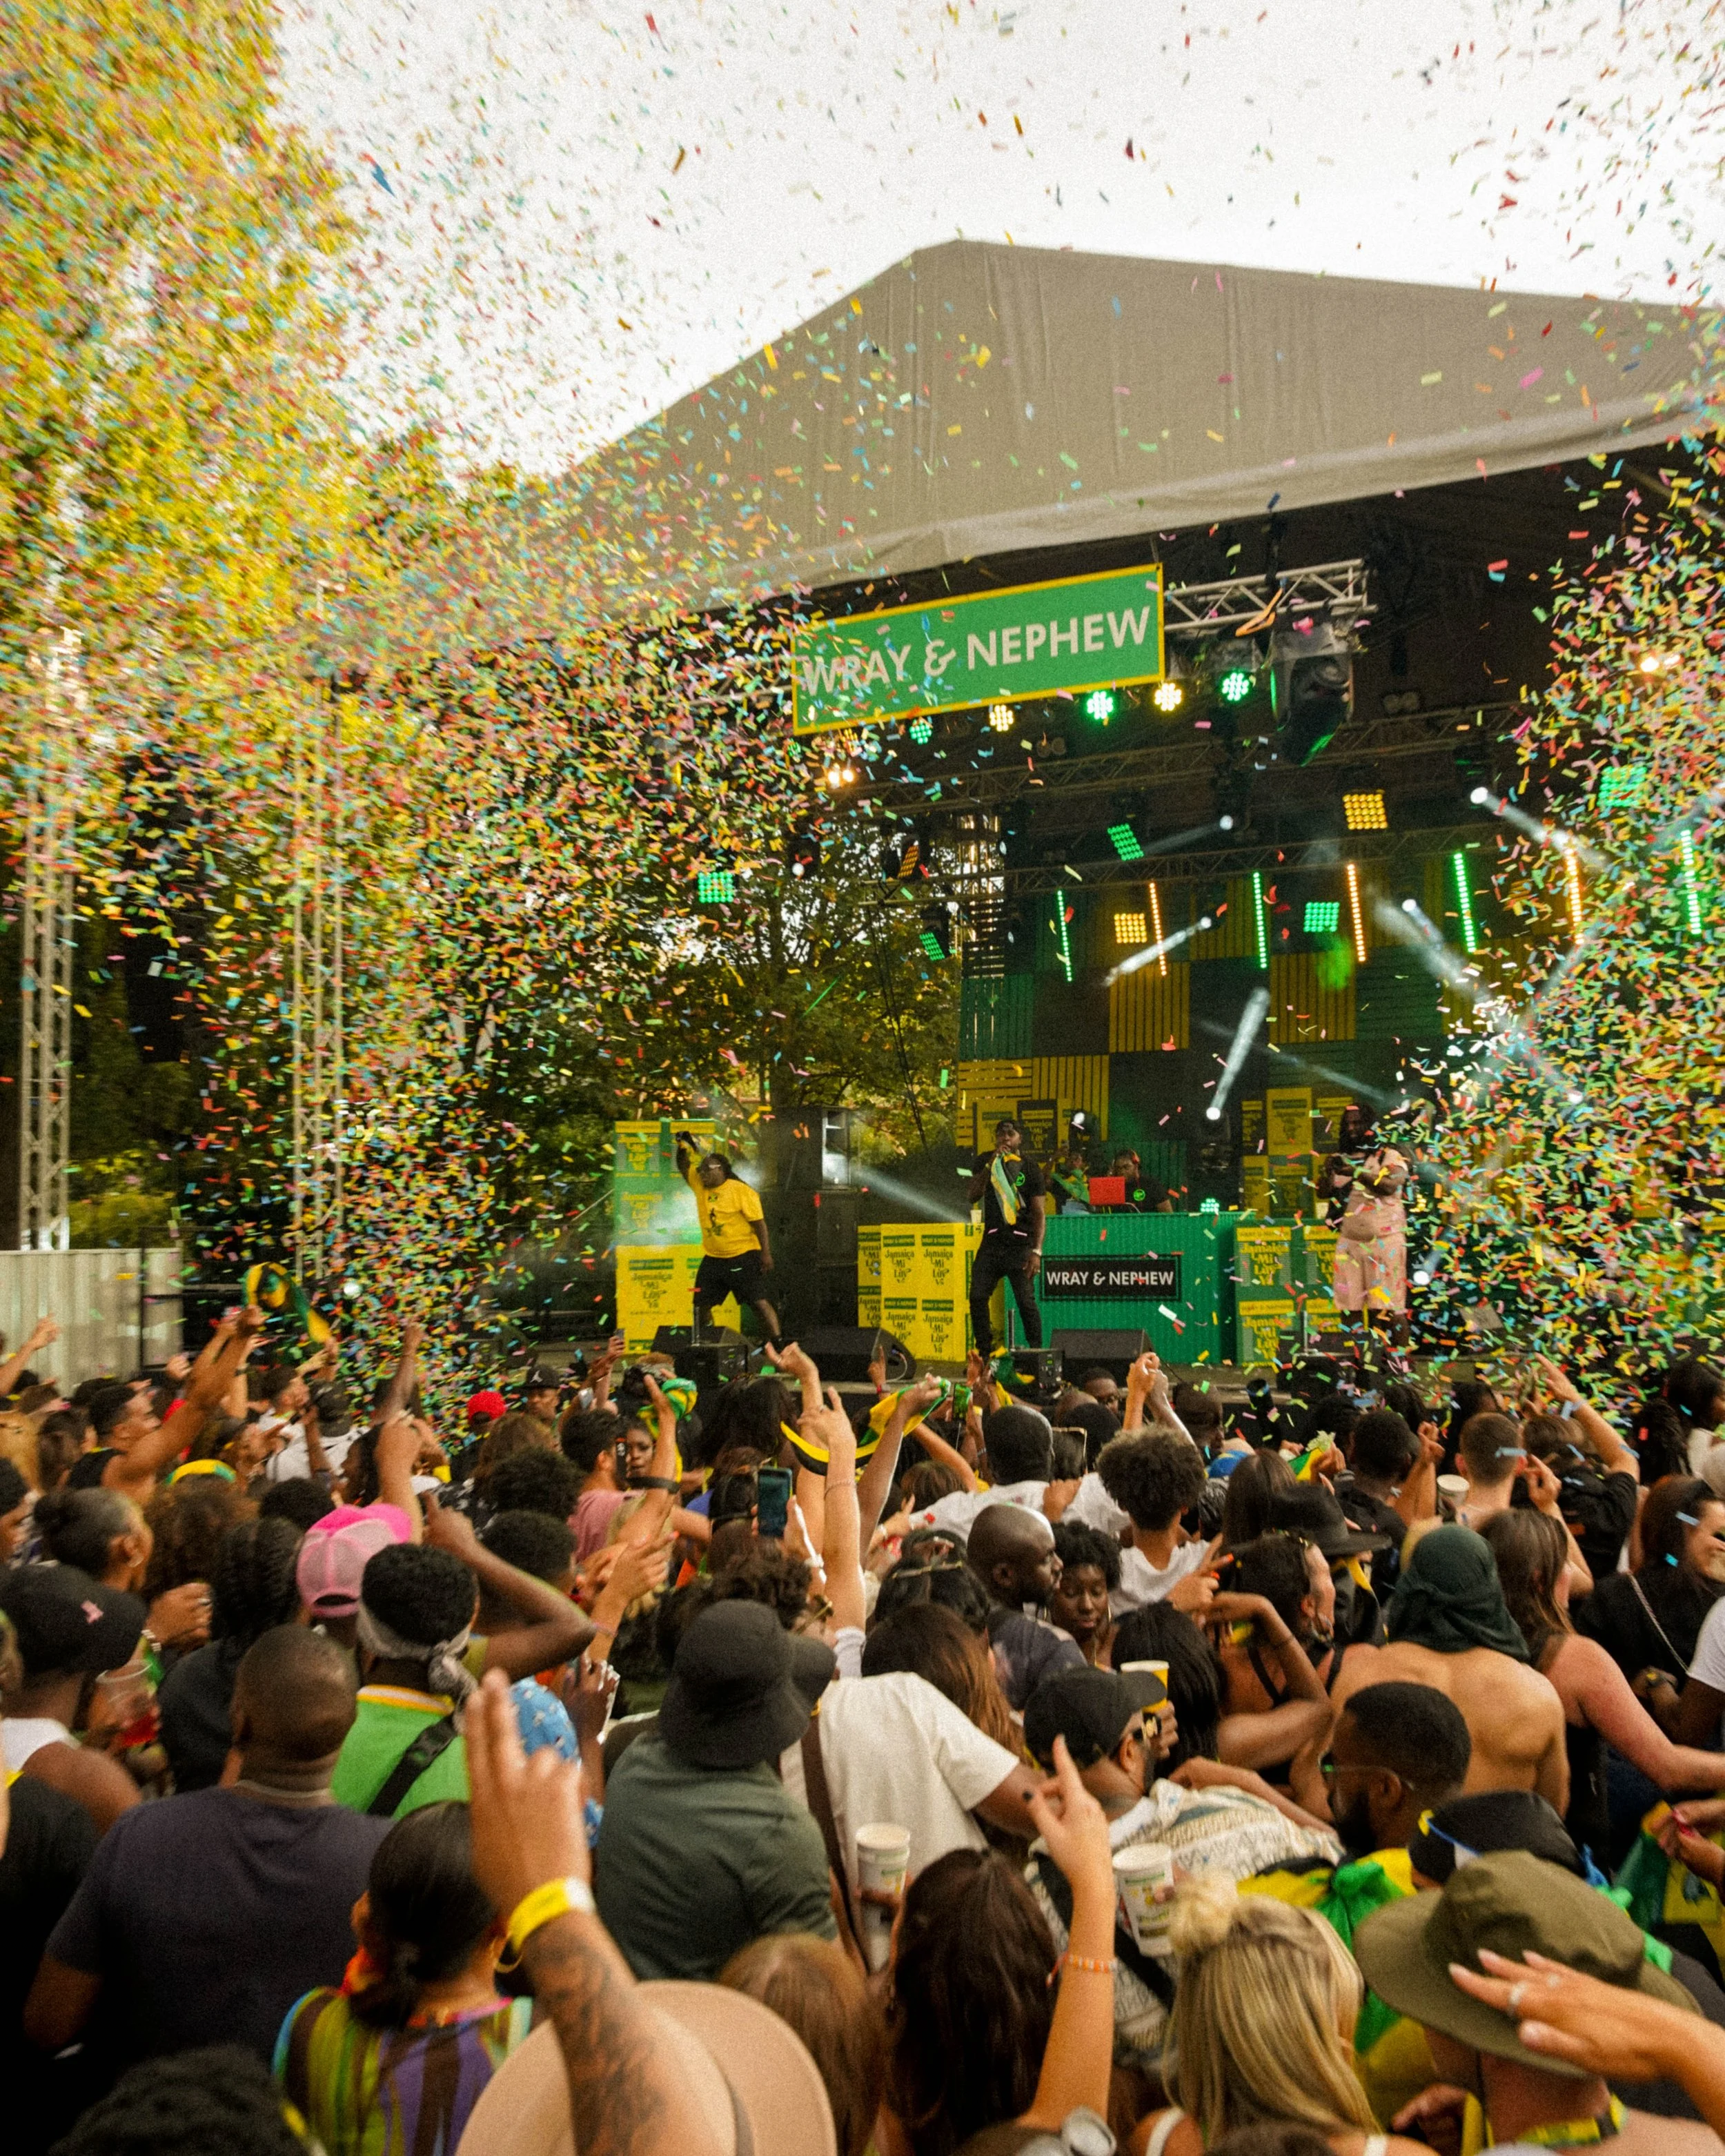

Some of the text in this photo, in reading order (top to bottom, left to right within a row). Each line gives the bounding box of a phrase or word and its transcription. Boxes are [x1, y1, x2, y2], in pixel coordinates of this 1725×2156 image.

[800, 605, 1151, 695] WRAY & NEPHEW
[1046, 1271, 1174, 1286] WRAY & NEPHEW
